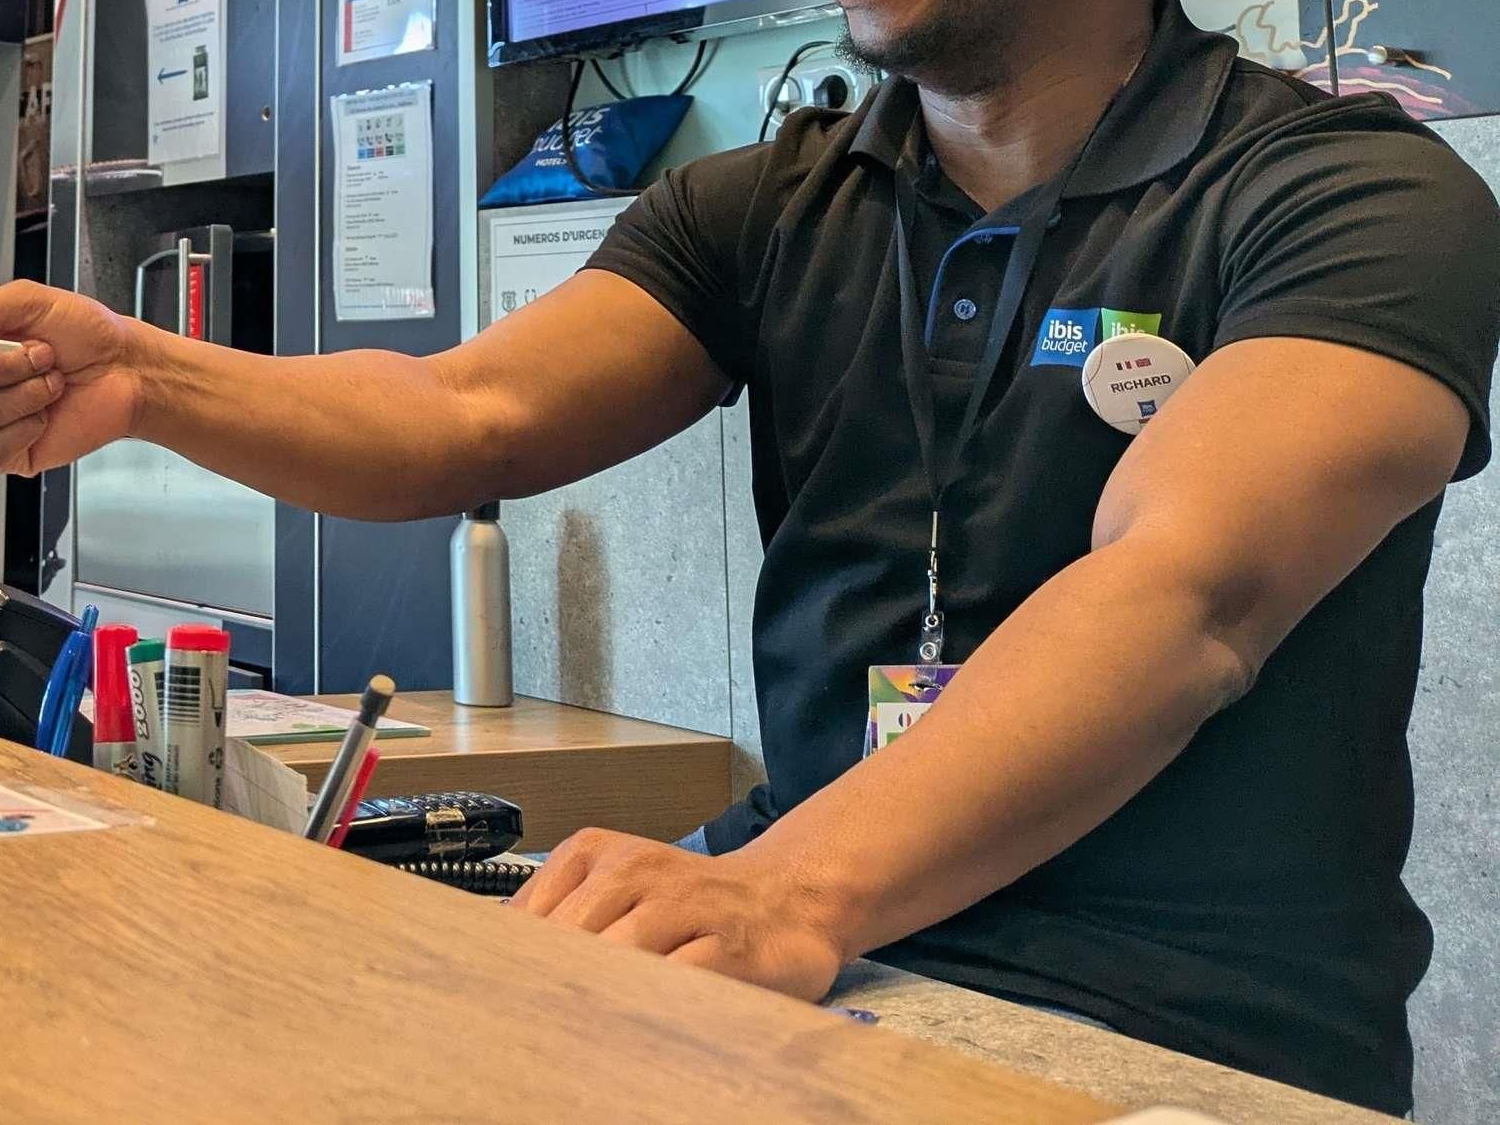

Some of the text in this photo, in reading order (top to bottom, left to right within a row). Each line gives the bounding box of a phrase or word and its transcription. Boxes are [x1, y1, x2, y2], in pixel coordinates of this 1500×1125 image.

[513, 228, 606, 245] NUMEROS D'URGEN
[1048, 320, 1083, 341] ibis
[1110, 321, 1145, 335] ibi
[1041, 339, 1087, 355] budget
[1111, 374, 1171, 393] RICHARD
[130, 668, 150, 740] 2000
